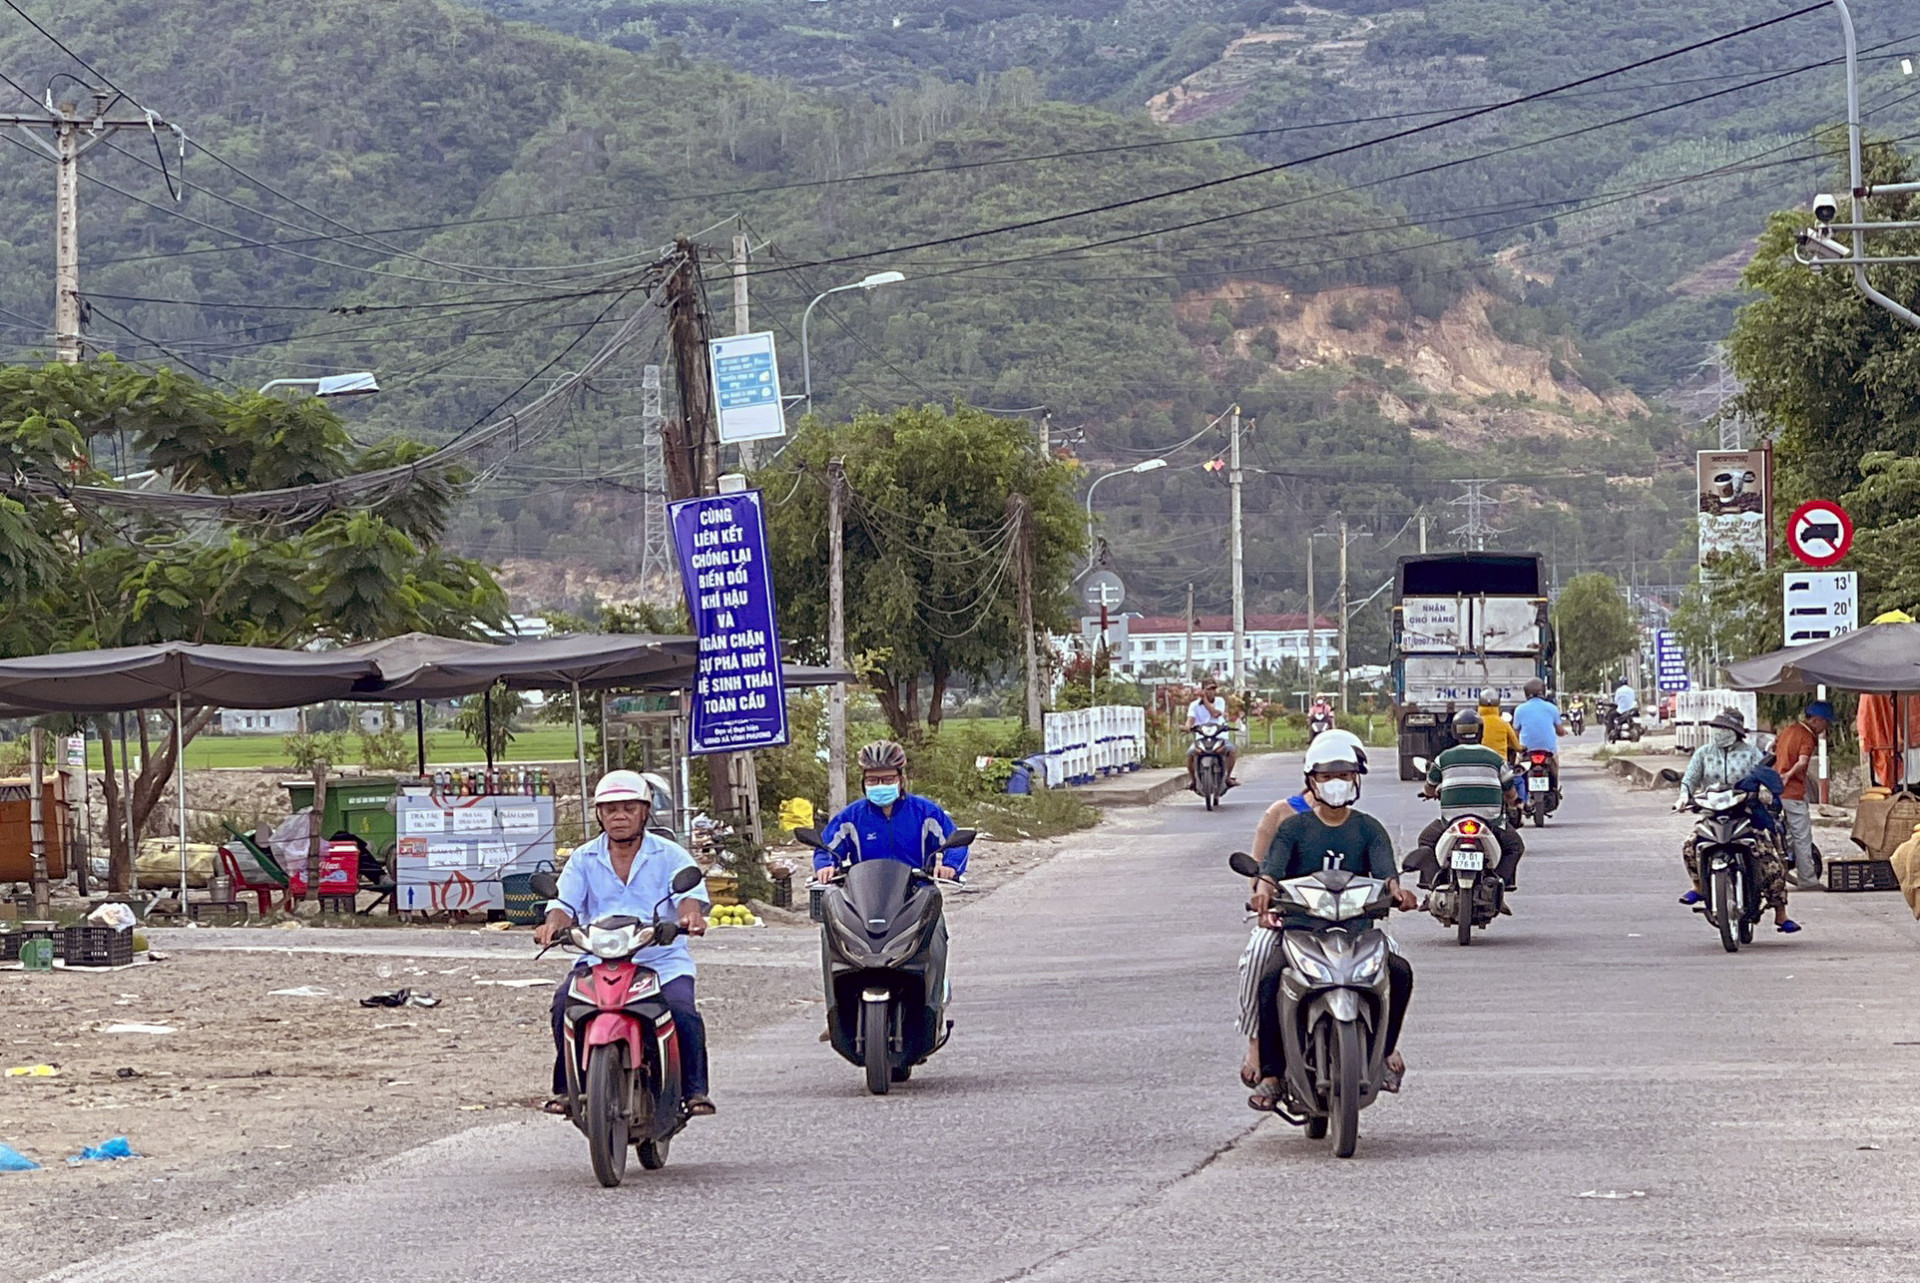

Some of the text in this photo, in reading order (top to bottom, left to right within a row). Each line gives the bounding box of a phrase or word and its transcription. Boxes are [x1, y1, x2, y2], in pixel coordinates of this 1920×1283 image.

[700, 508, 732, 525] CÙNG
[694, 524, 743, 547] LIÊN KẾT
[692, 548, 729, 568] CHỐNG
[699, 569, 725, 589] BIẾN
[701, 589, 748, 609] KHÍ HẬU
[716, 611, 735, 628] VÀ
[730, 629, 765, 649] CHẶN
[714, 652, 739, 671] PHÁ
[711, 676, 742, 692] SINH
[743, 669, 773, 689] THÁI
[704, 695, 736, 714] TOÀN
